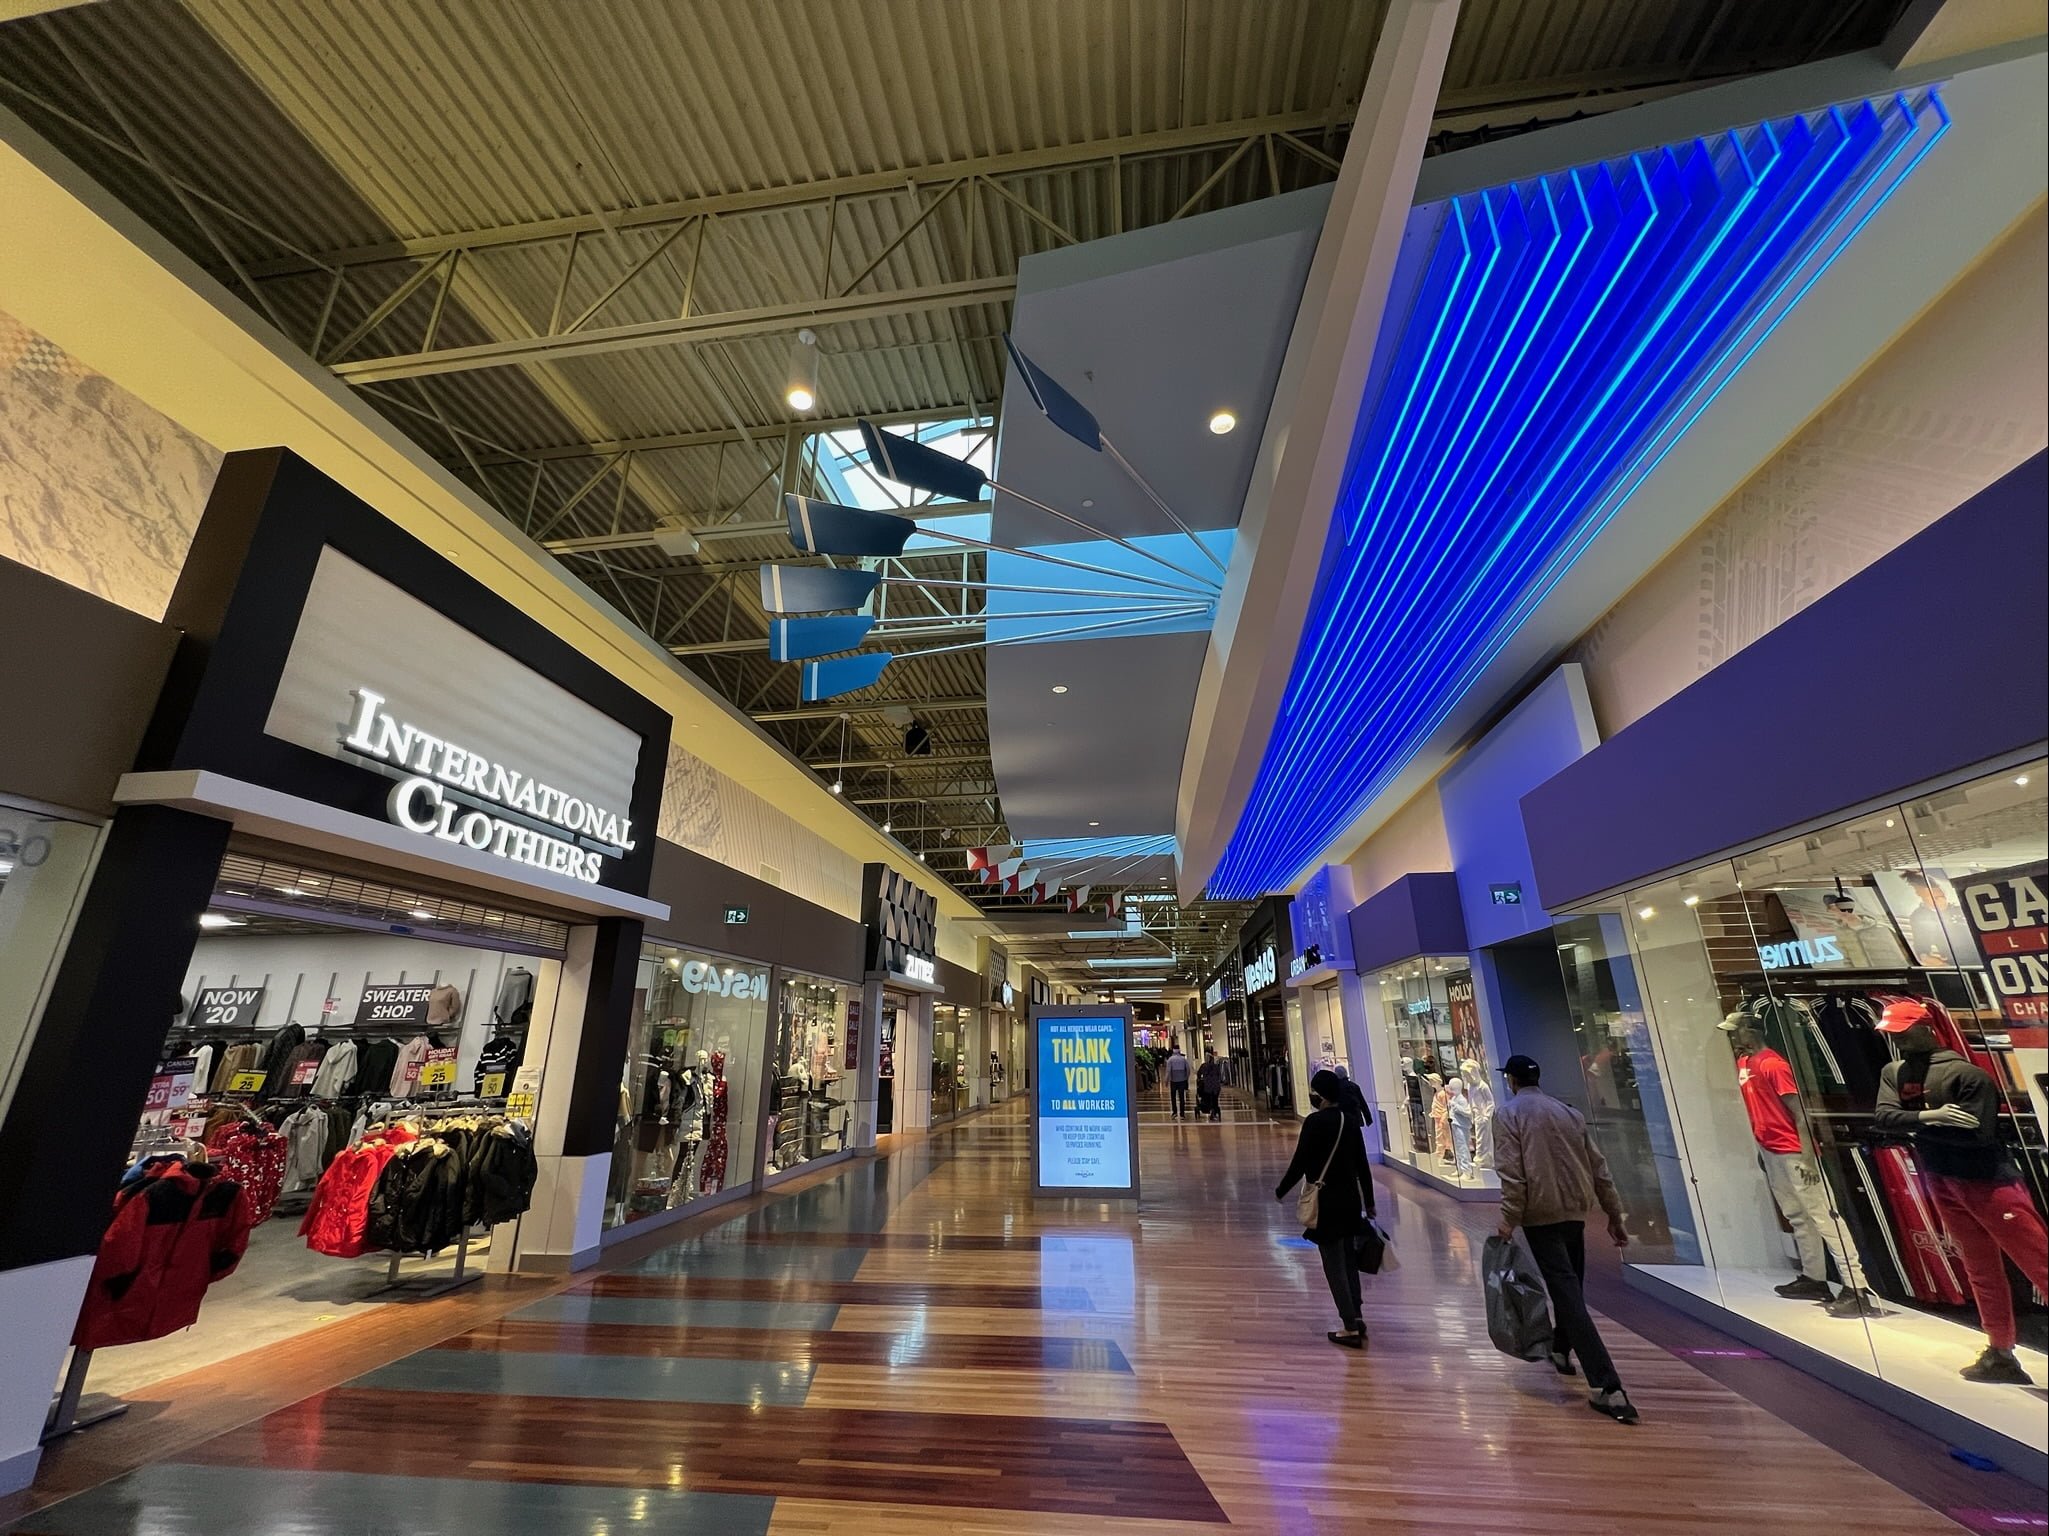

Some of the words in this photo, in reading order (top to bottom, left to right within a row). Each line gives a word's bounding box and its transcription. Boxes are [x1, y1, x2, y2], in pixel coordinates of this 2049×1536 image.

[347, 687, 636, 850] INTERNATIONAL
[393, 777, 603, 884] CLOTHIERS
[203, 990, 258, 1005] NOW
[362, 989, 431, 1003] SWEATER
[1448, 982, 1472, 1002] HOLLY
[206, 1006, 239, 1024] $20
[371, 1005, 413, 1019] SHOP
[427, 1047, 456, 1056] HOLIDAY
[1051, 1038, 1112, 1064] THANK
[1064, 1067, 1101, 1094] YOU
[1051, 1100, 1061, 1111] TO
[1062, 1100, 1077, 1111] ALL
[1078, 1100, 1115, 1111] WORKERS
